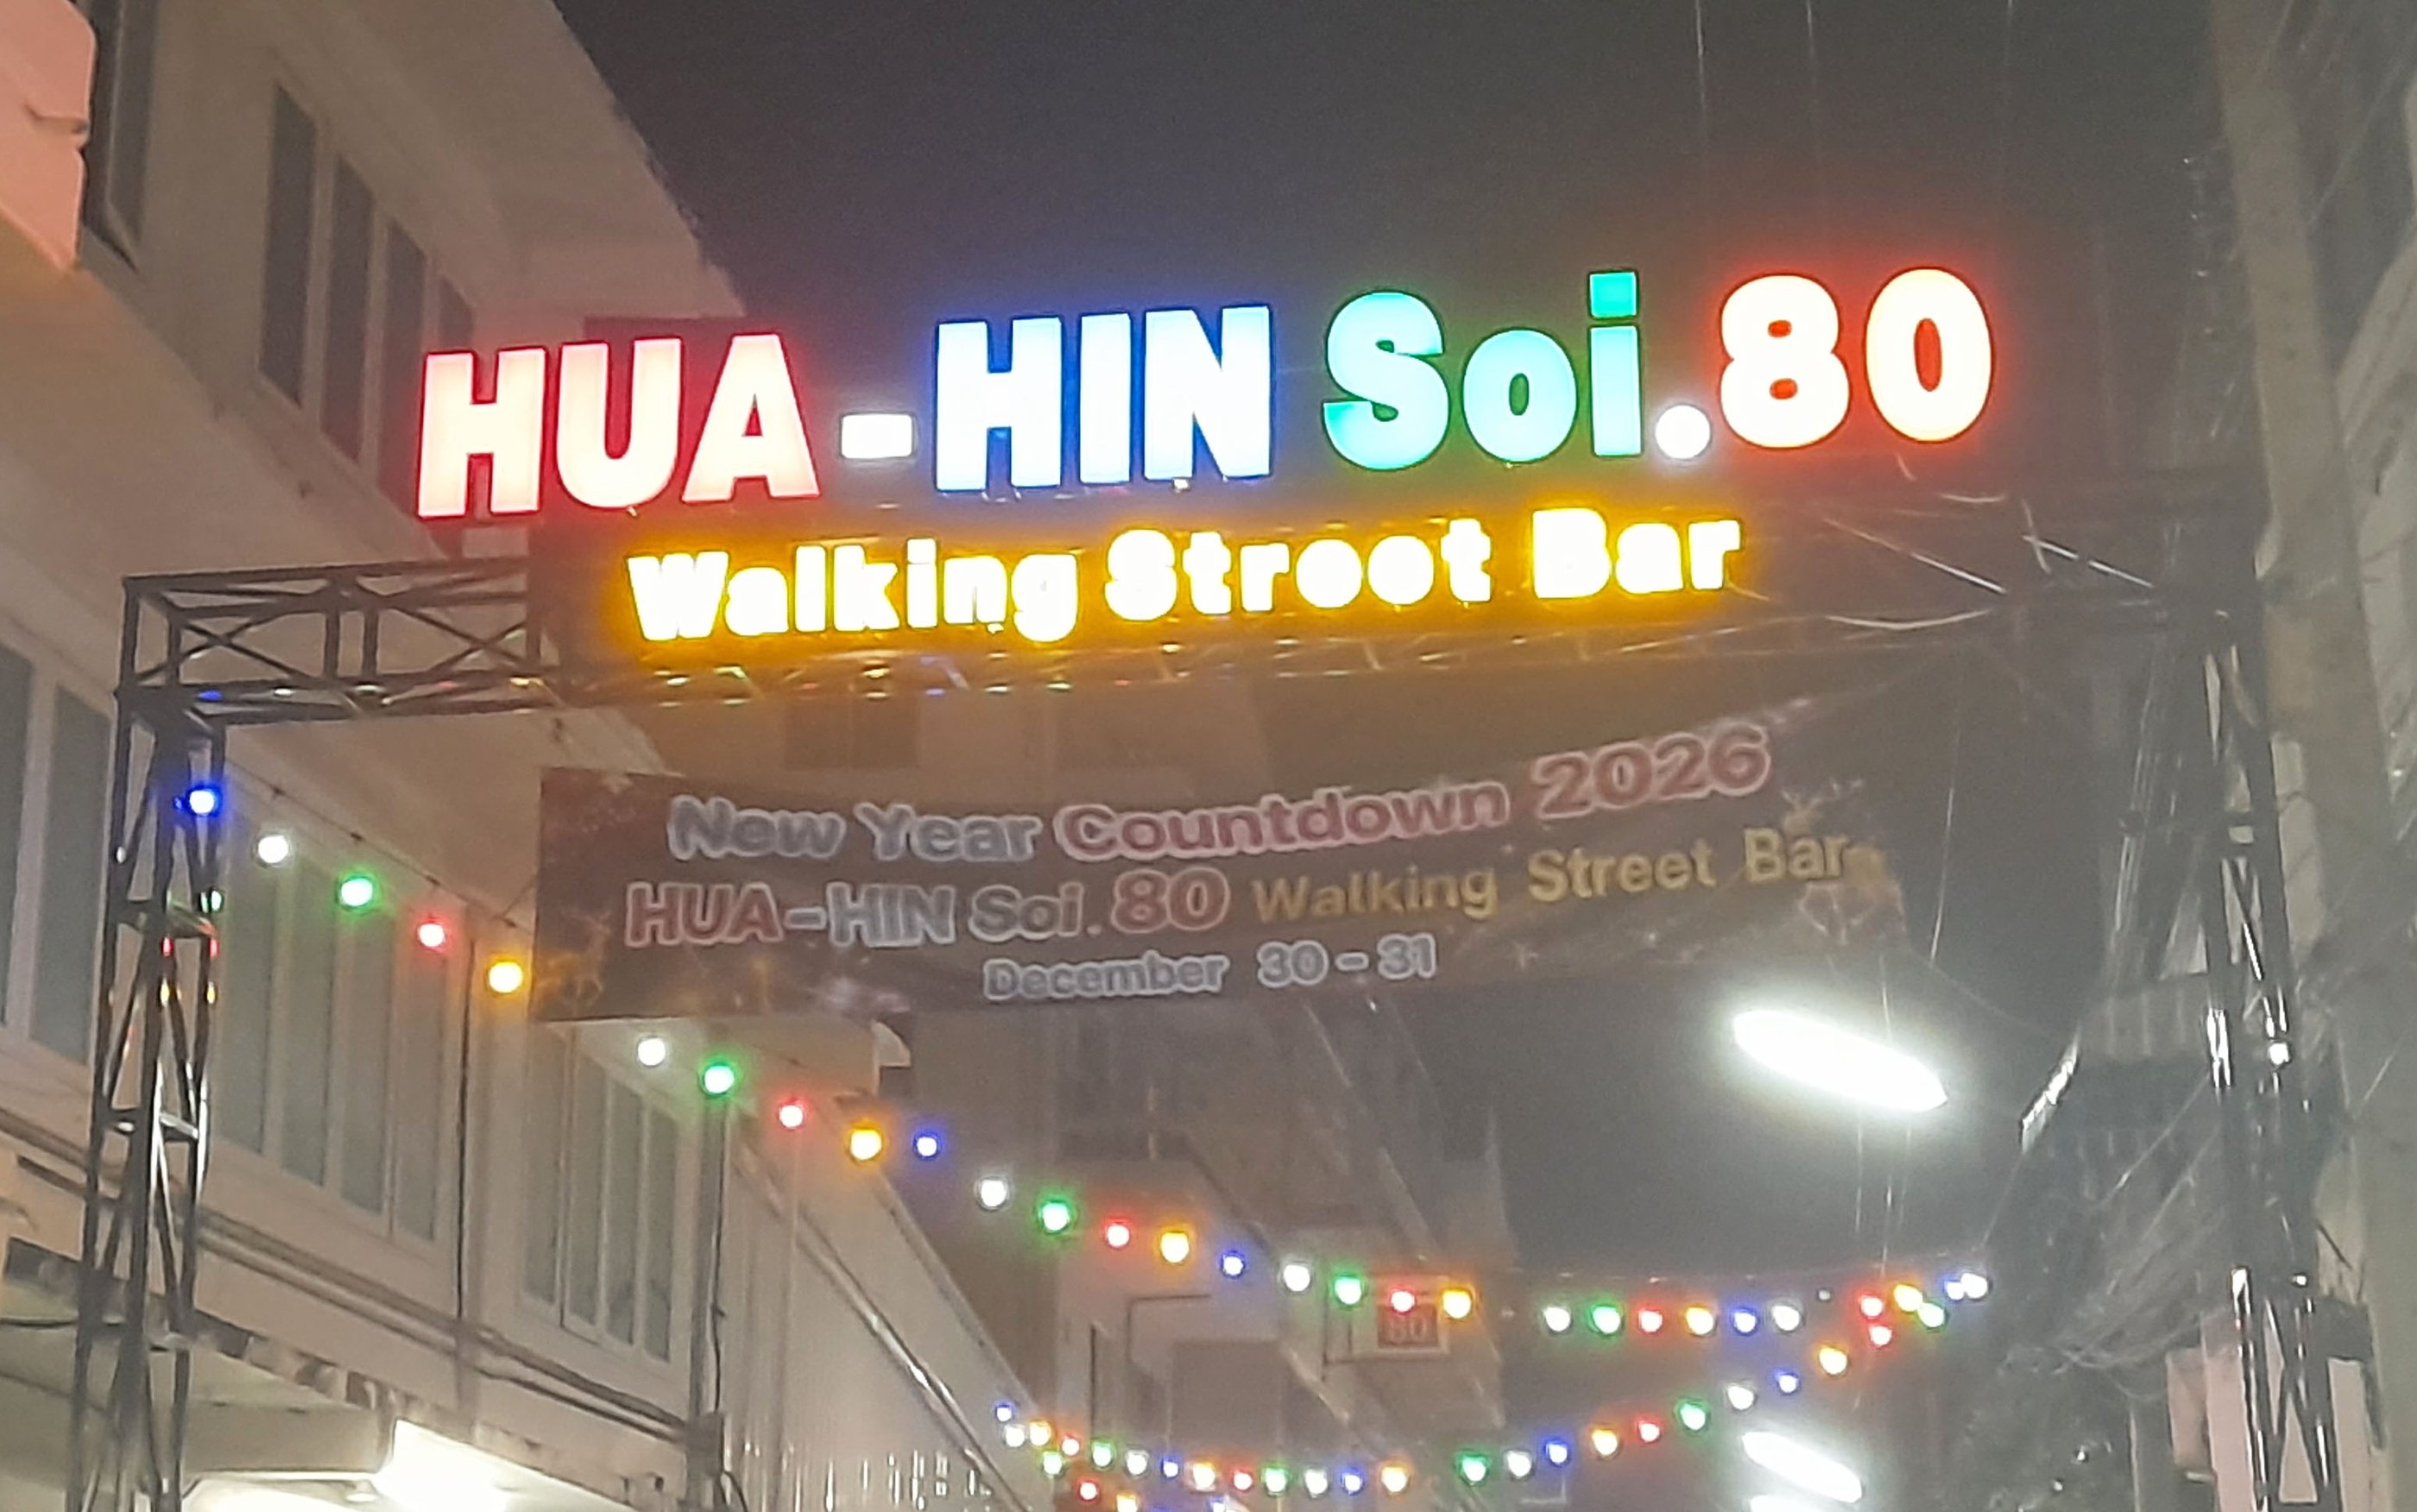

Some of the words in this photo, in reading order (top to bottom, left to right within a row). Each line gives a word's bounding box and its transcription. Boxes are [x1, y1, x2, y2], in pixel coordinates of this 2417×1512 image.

[626, 536, 1080, 644] Walking
[1530, 507, 1743, 601] Bar
[667, 794, 847, 860] New
[854, 802, 1043, 862] Year
[1052, 779, 1512, 863] Countdown
[1529, 720, 1773, 822] 2026
[1252, 865, 1499, 921] Walking
[1526, 837, 1718, 904] Street
[1743, 826, 1851, 885] Bar
[982, 949, 1231, 1001] December
